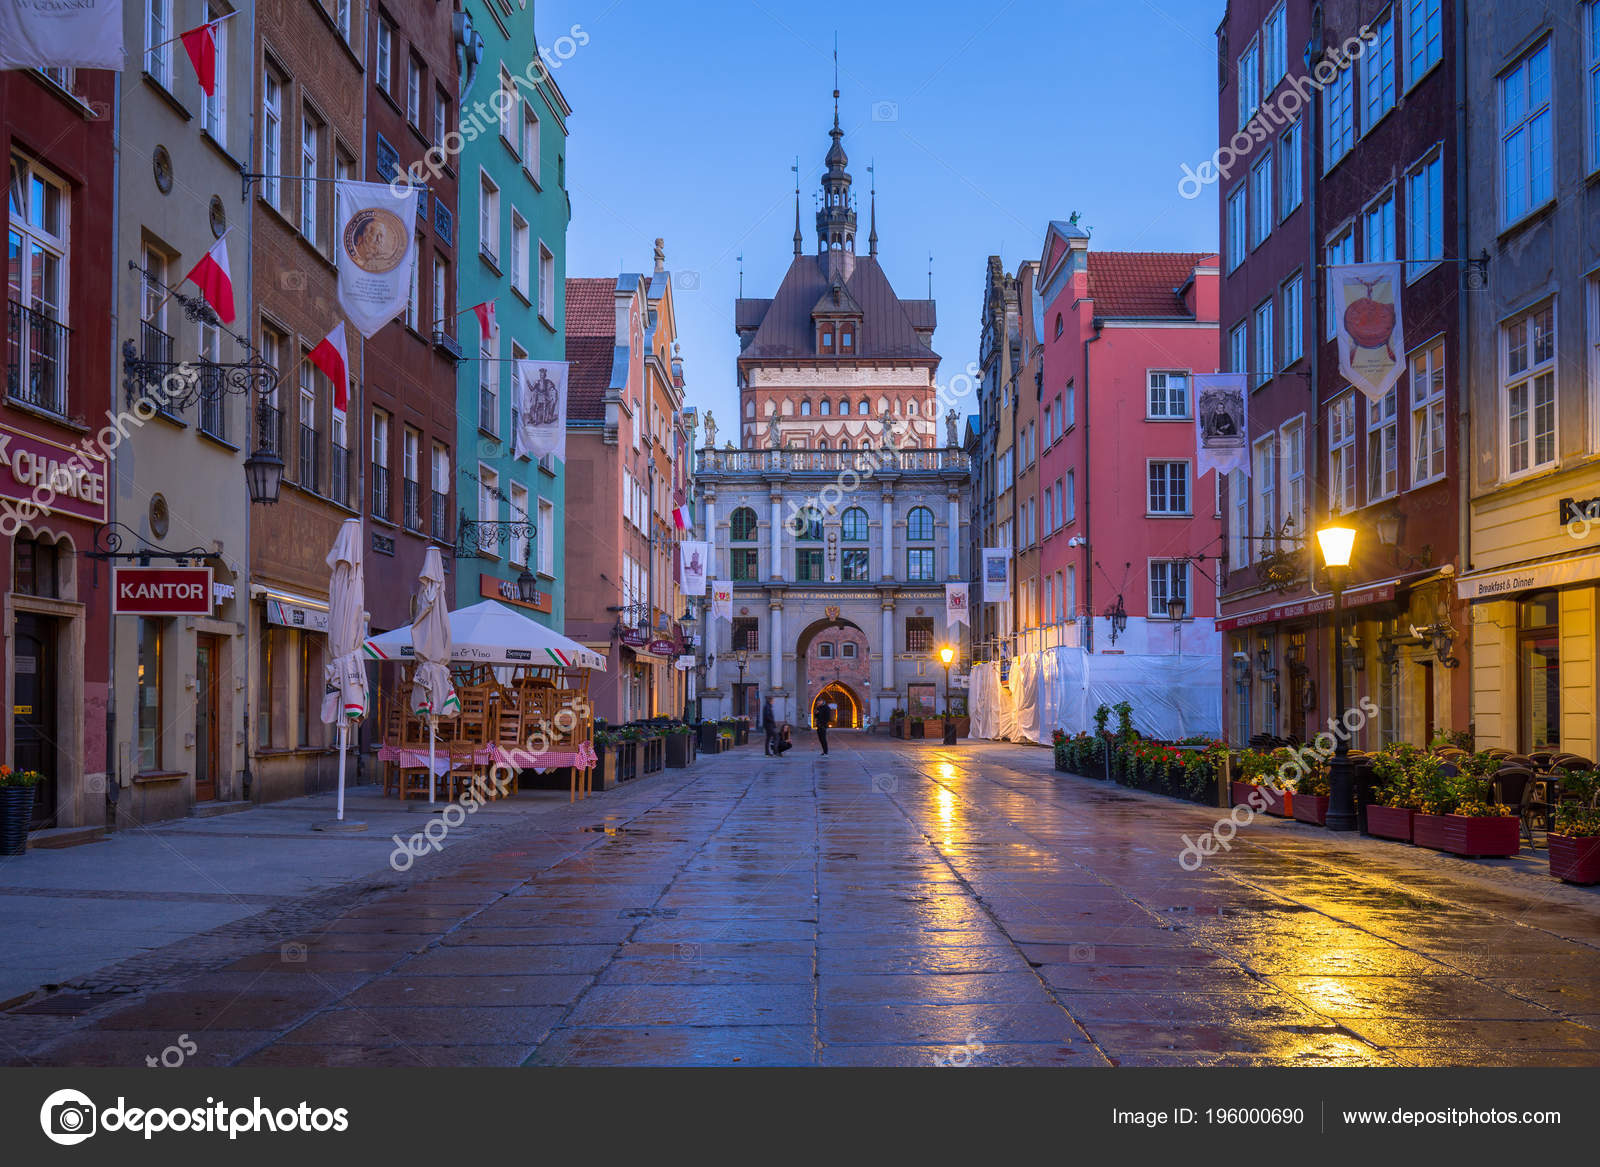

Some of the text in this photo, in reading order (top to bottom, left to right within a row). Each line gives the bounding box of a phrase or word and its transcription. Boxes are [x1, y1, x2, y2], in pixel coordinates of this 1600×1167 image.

[120, 583, 203, 599] KANTOR
[1478, 580, 1506, 595] Breakfast
[1512, 577, 1535, 589] Dinner
[472, 648, 491, 658] Vino
